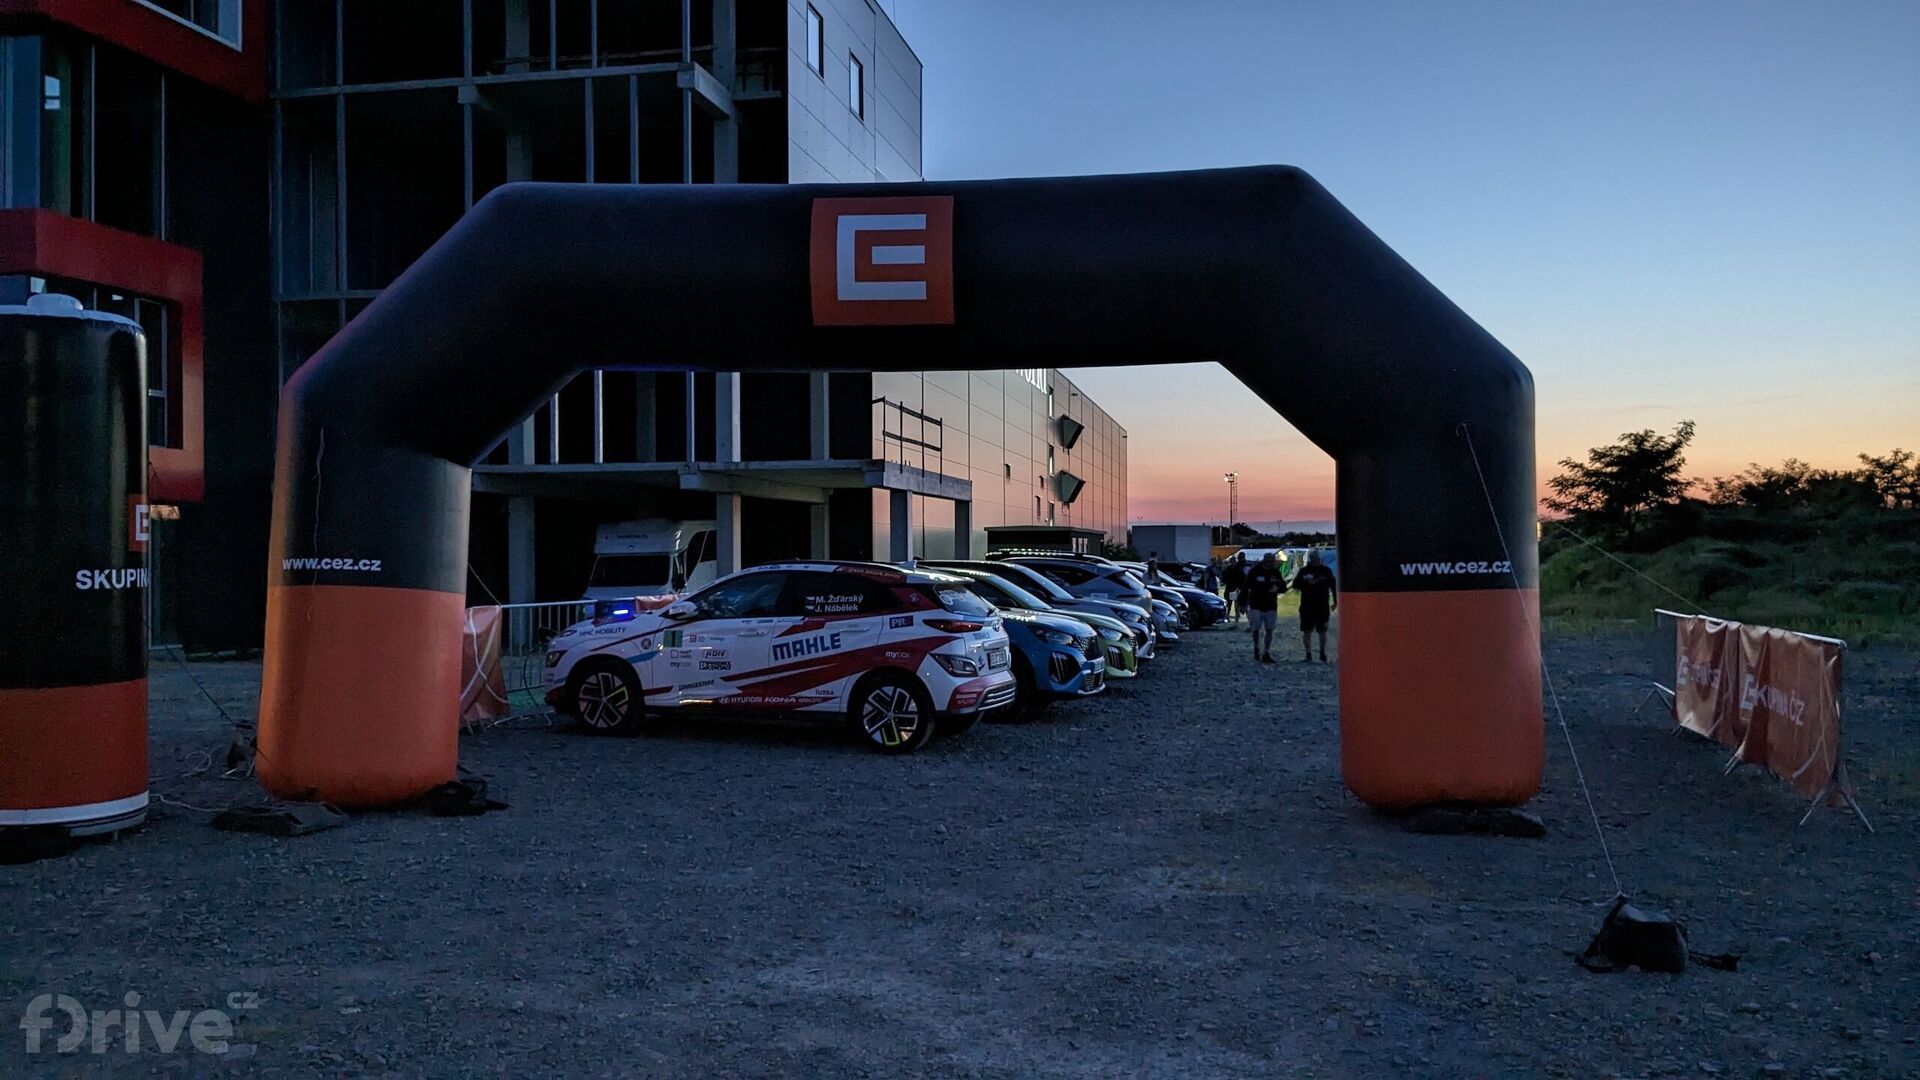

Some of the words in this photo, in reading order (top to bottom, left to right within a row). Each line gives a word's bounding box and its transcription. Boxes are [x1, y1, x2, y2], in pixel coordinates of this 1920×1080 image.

[282, 558, 382, 572] www.cez.cz
[1400, 560, 1511, 576] www.cez.cz
[772, 632, 842, 661] MAHLE
